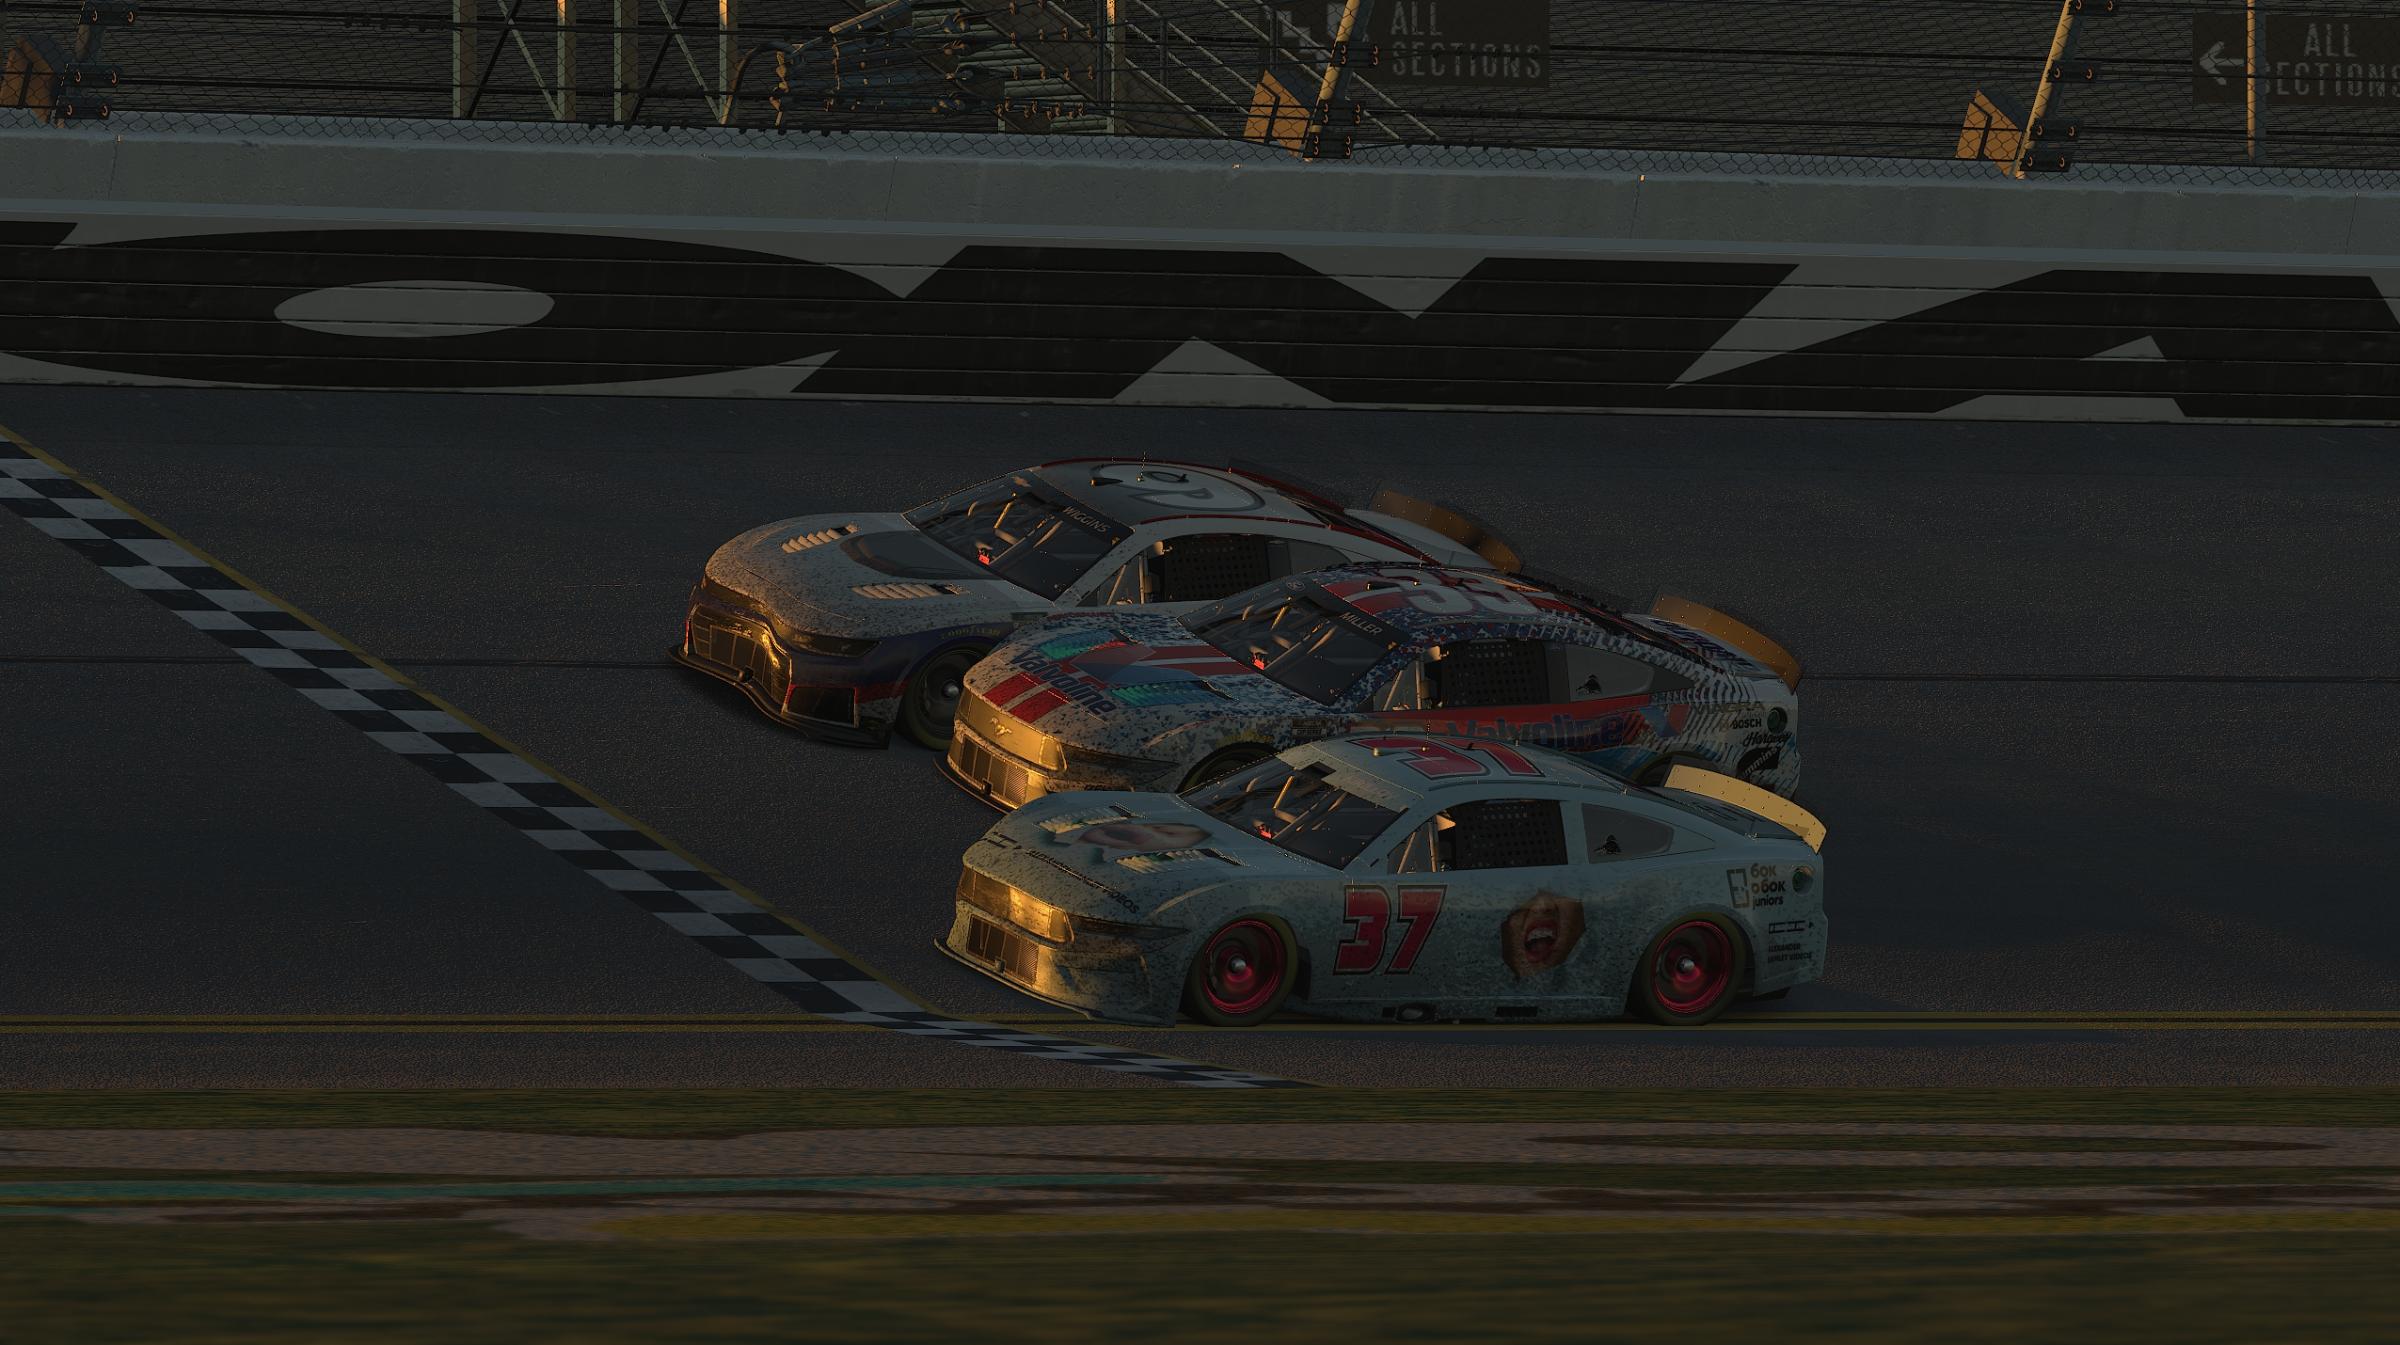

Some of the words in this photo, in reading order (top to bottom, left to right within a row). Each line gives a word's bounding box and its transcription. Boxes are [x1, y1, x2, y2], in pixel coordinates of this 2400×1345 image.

[1390, 0, 1443, 37] ALL
[2304, 23, 2358, 58] ALL
[1391, 41, 1542, 79] SECTIONS
[0, 221, 2400, 421] ONA
[1062, 505, 1112, 533] WIGGINS
[1339, 611, 1384, 637] MILLER
[1009, 648, 1118, 716] Valvoline
[1731, 718, 1763, 730] BOSCH
[1752, 895, 1784, 910] juniors
[1333, 884, 1448, 976] 37
